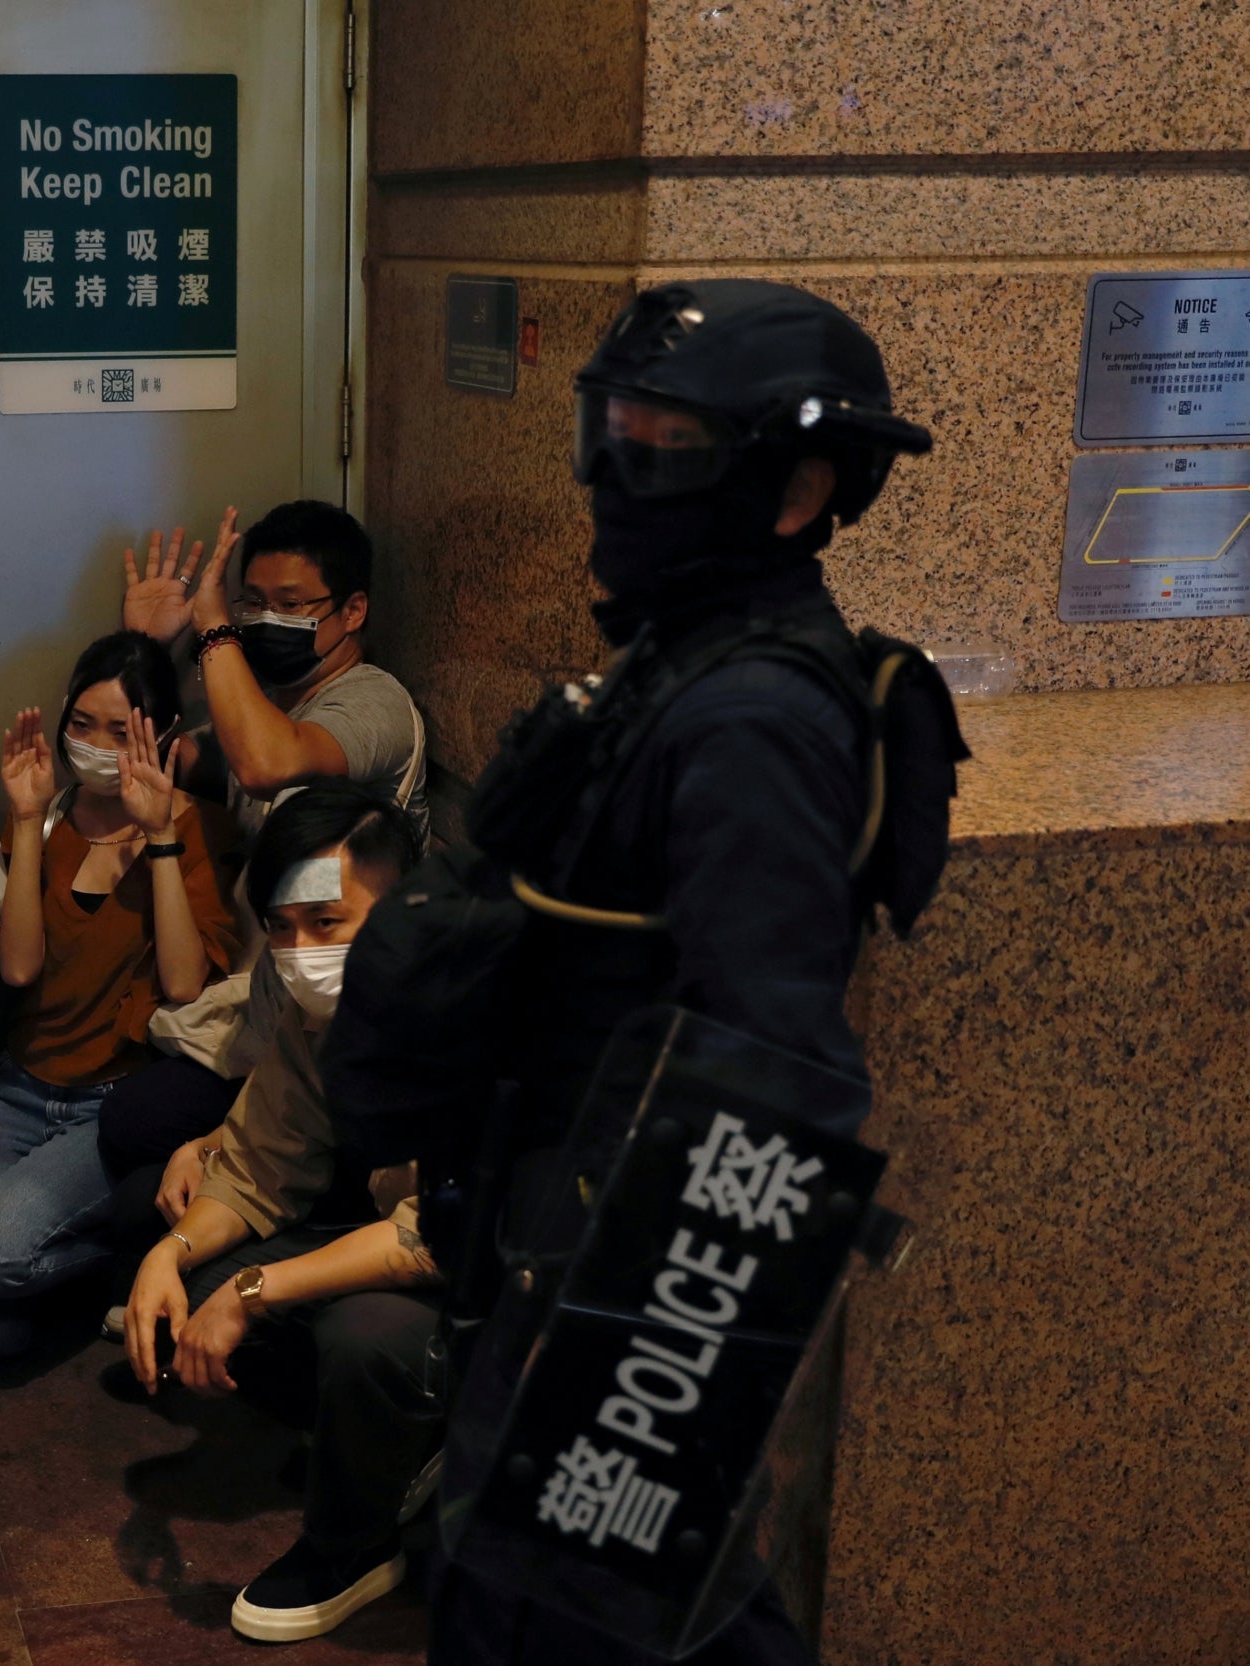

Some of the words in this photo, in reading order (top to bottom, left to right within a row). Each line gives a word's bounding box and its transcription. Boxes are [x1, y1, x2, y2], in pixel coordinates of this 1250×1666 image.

[20, 119, 62, 151] No
[72, 118, 212, 158] Smoking
[21, 166, 102, 205] Keep
[120, 165, 212, 198] Clean
[22, 228, 210, 263] 嚴禁吸煙
[23, 274, 209, 309] 保持清潔
[1174, 299, 1218, 314] NOTICE
[1177, 318, 1211, 334] 通告
[681, 1111, 826, 1242] 察
[596, 1227, 759, 1457] POLICE
[536, 1434, 681, 1555] 警
